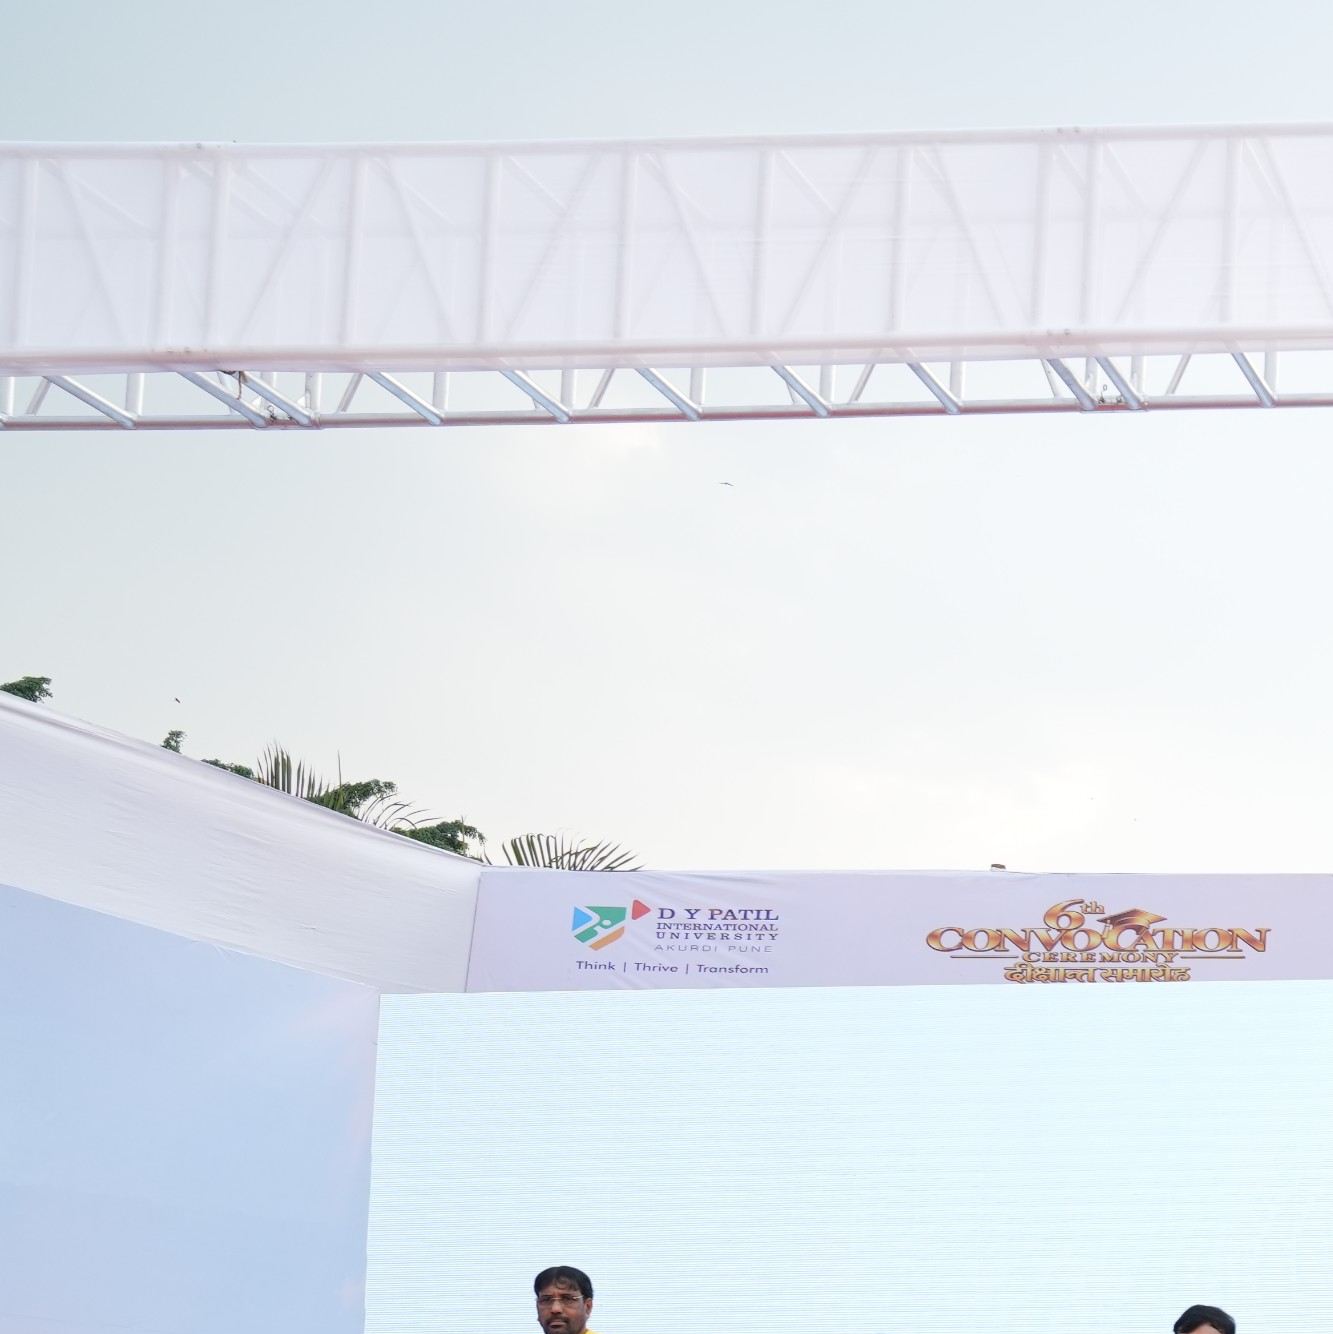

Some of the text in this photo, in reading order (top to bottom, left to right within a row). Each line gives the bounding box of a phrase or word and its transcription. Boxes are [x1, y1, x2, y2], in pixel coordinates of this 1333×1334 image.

[658, 908, 779, 920] D Y PATIL
[1044, 899, 1106, 930] 6th
[657, 923, 778, 931] INTERNATIONAL
[656, 932, 779, 940] UNIVERSITY
[925, 925, 1272, 952] CONVOCATION
[654, 944, 773, 953] AKURDI PUNE
[1022, 952, 1181, 963] CEREMONY
[576, 961, 615, 971] Think
[635, 963, 678, 973] Thrive
[697, 964, 769, 974] Transform
[1004, 962, 1191, 983] दीक्षान्त समारोह
